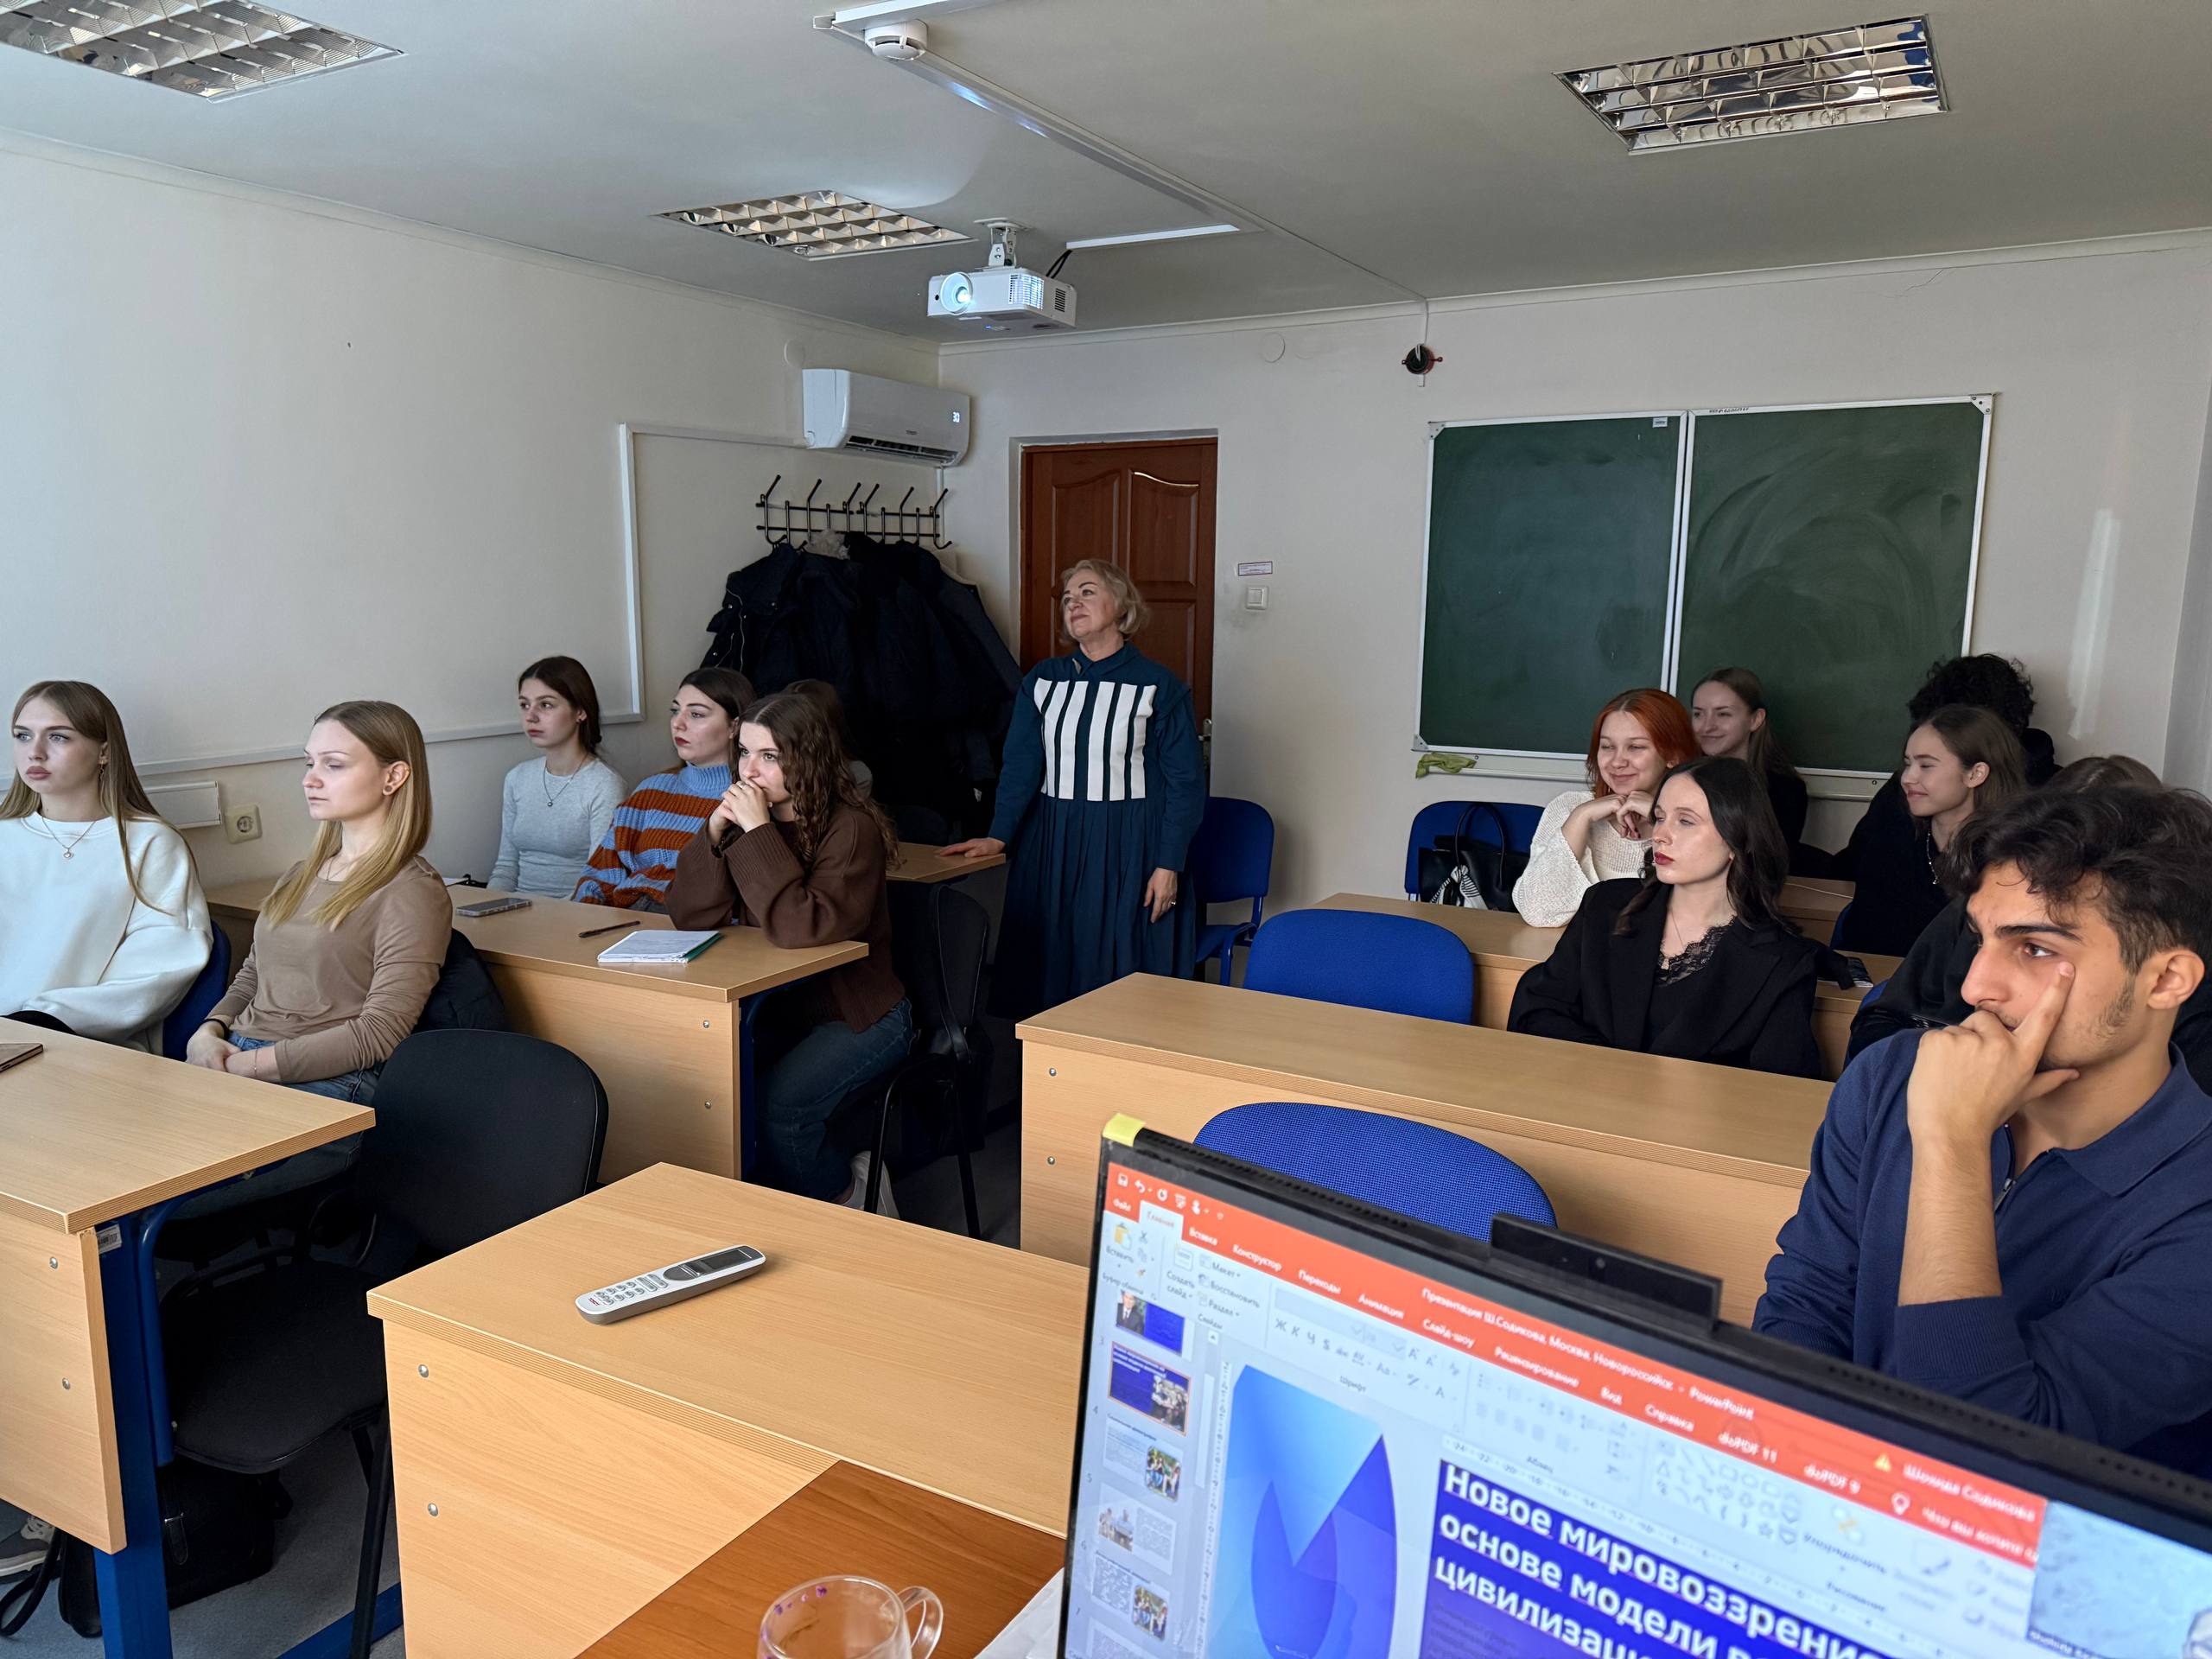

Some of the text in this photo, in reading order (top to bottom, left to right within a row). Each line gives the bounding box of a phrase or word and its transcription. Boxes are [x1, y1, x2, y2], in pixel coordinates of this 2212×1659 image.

[1189, 1226, 1218, 1246] Вставка
[1211, 1262, 1236, 1278] Макет
[1232, 1243, 1282, 1272] Конструктор
[1166, 1269, 1196, 1290] Создать
[1298, 1268, 1341, 1294] Переходы
[1209, 1298, 1235, 1318] Раздел
[1358, 1294, 1405, 1320] Анимация
[1422, 1319, 1475, 1349] Слайд-шоу
[1422, 1287, 1483, 1319] Презентация
[1688, 1385, 1754, 1421] PowerPoint
[1494, 1345, 1580, 1389] Рецензирование
[1600, 1386, 1624, 1407] Вид
[1645, 1403, 1695, 1433] Справка
[1444, 1464, 1553, 1536] Новое
[1560, 1520, 1890, 1659] мировоззрени
[1440, 1514, 1563, 1591] основе
[1569, 1573, 1719, 1659] модели
